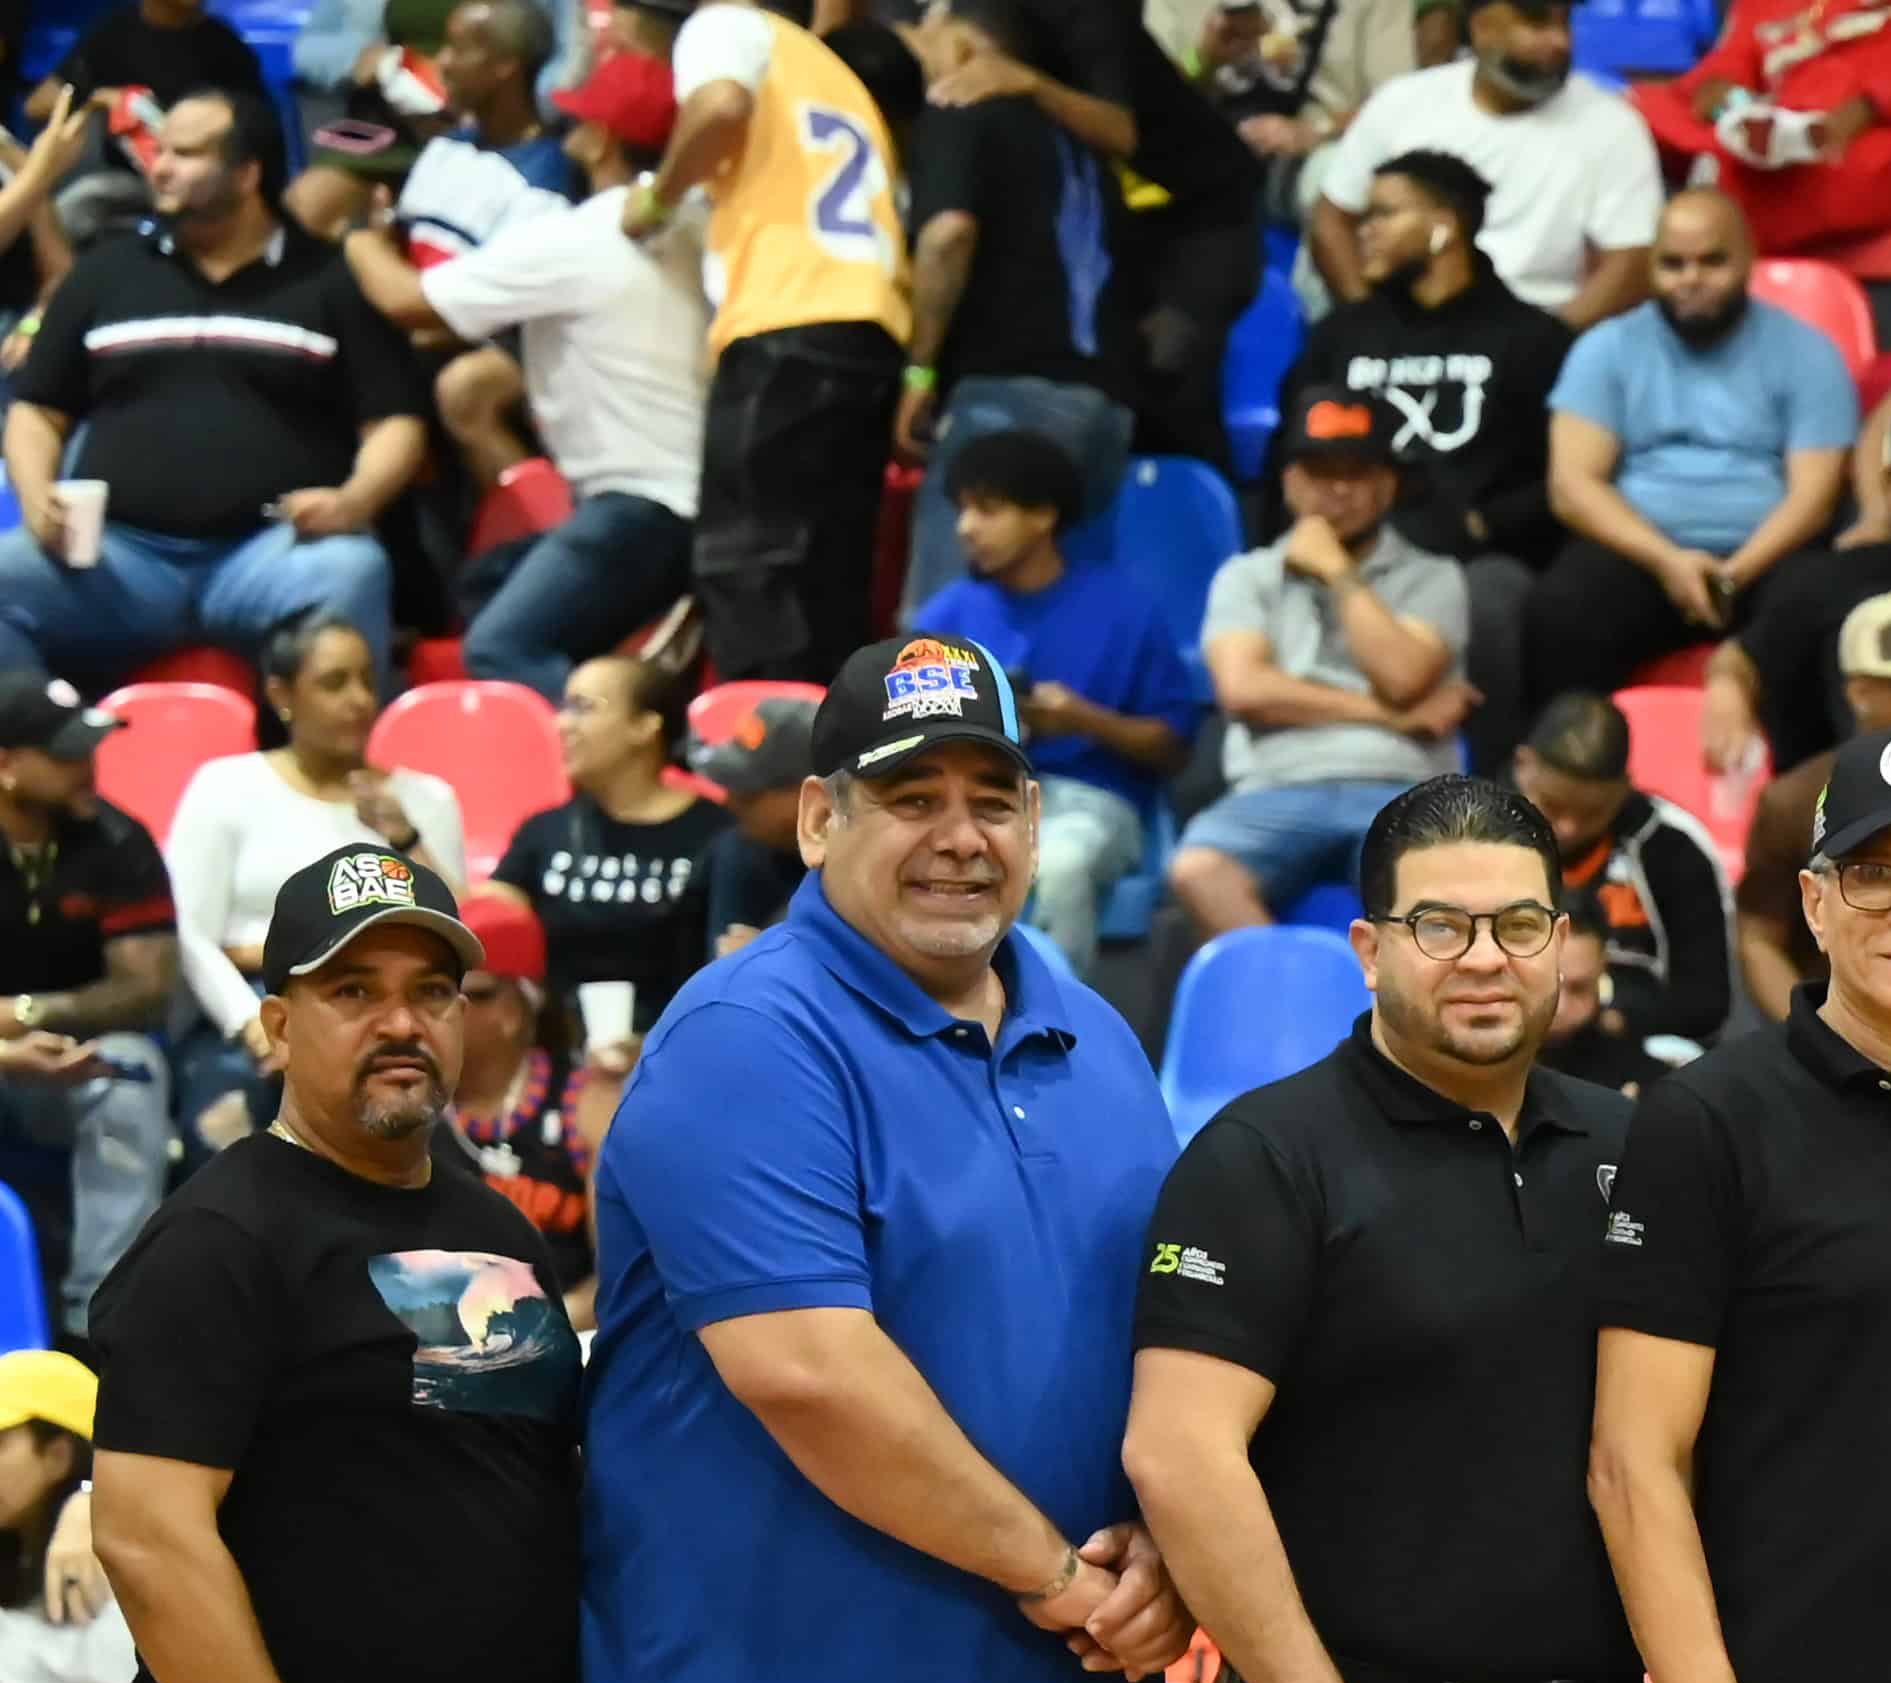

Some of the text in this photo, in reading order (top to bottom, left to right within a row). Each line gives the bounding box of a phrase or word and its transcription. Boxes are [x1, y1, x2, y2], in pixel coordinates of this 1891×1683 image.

[885, 665, 977, 702] BSE
[332, 876, 413, 910] BAE
[1150, 1242, 1182, 1273] 25
